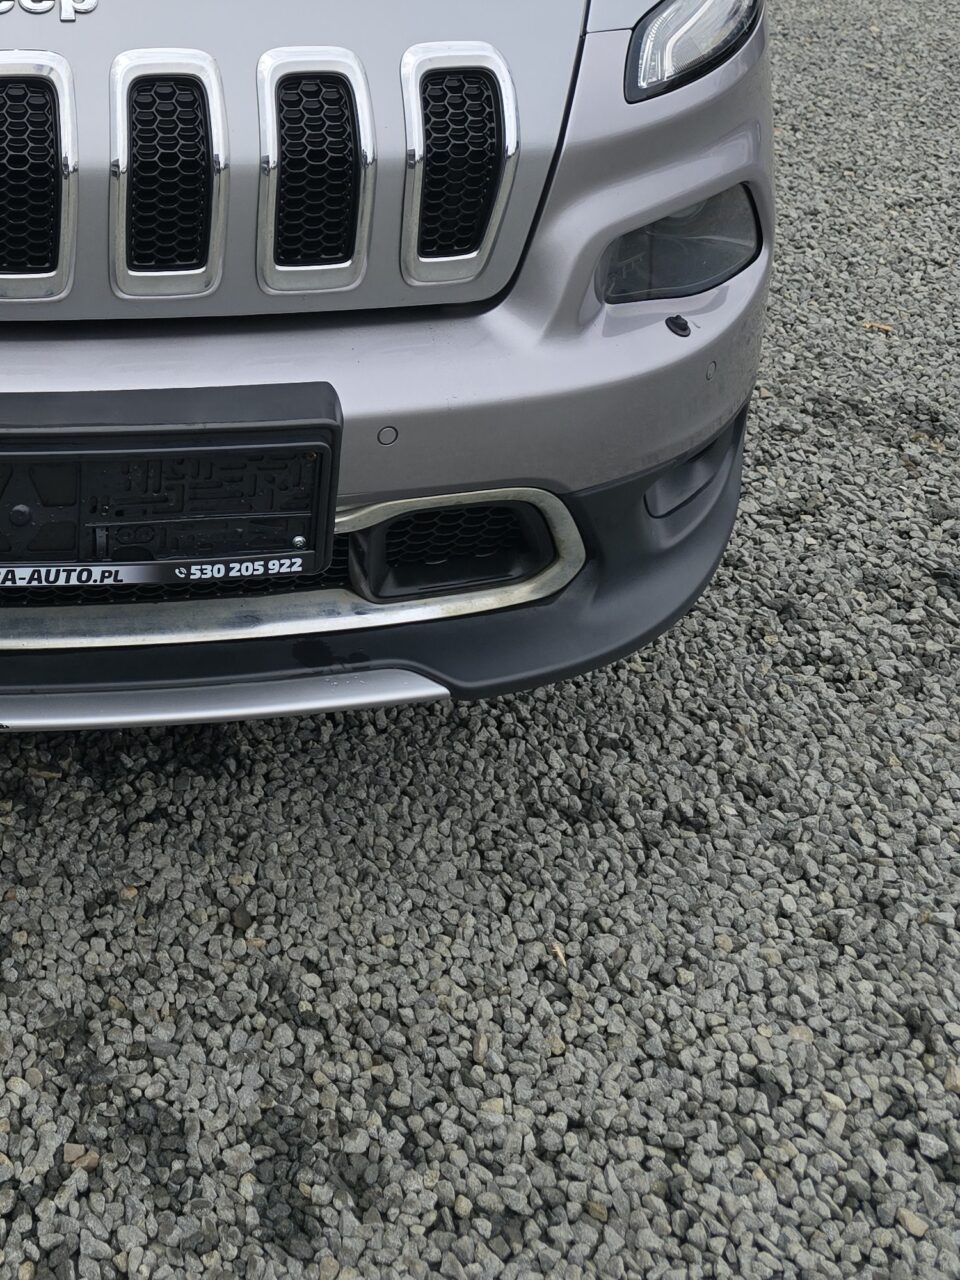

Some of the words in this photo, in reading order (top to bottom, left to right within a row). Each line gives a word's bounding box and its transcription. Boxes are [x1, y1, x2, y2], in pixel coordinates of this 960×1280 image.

[190, 564, 225, 579] 530
[228, 561, 265, 577] 205
[267, 558, 303, 574] 922
